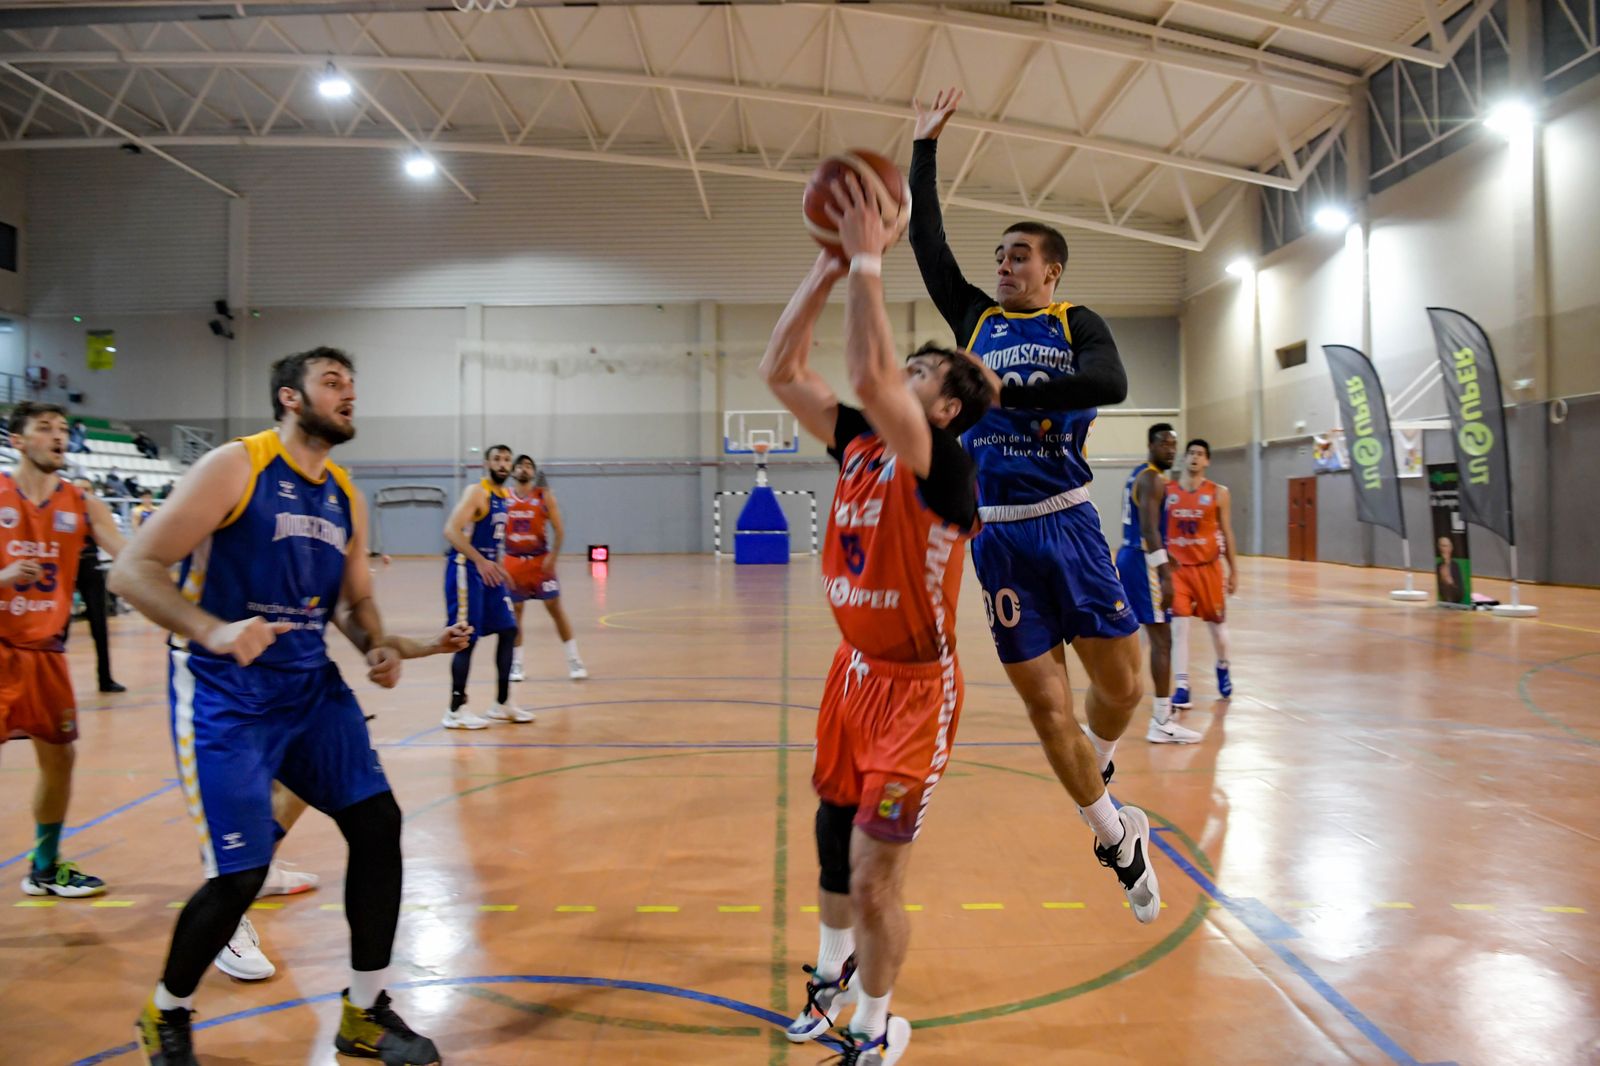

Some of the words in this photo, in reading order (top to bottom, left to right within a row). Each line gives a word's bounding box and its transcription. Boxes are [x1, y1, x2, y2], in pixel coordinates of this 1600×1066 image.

[982, 343, 1075, 375] NOVASCHOOL
[973, 433, 1006, 448] RINCÓN
[1009, 433, 1020, 443] de
[1023, 433, 1032, 443] la
